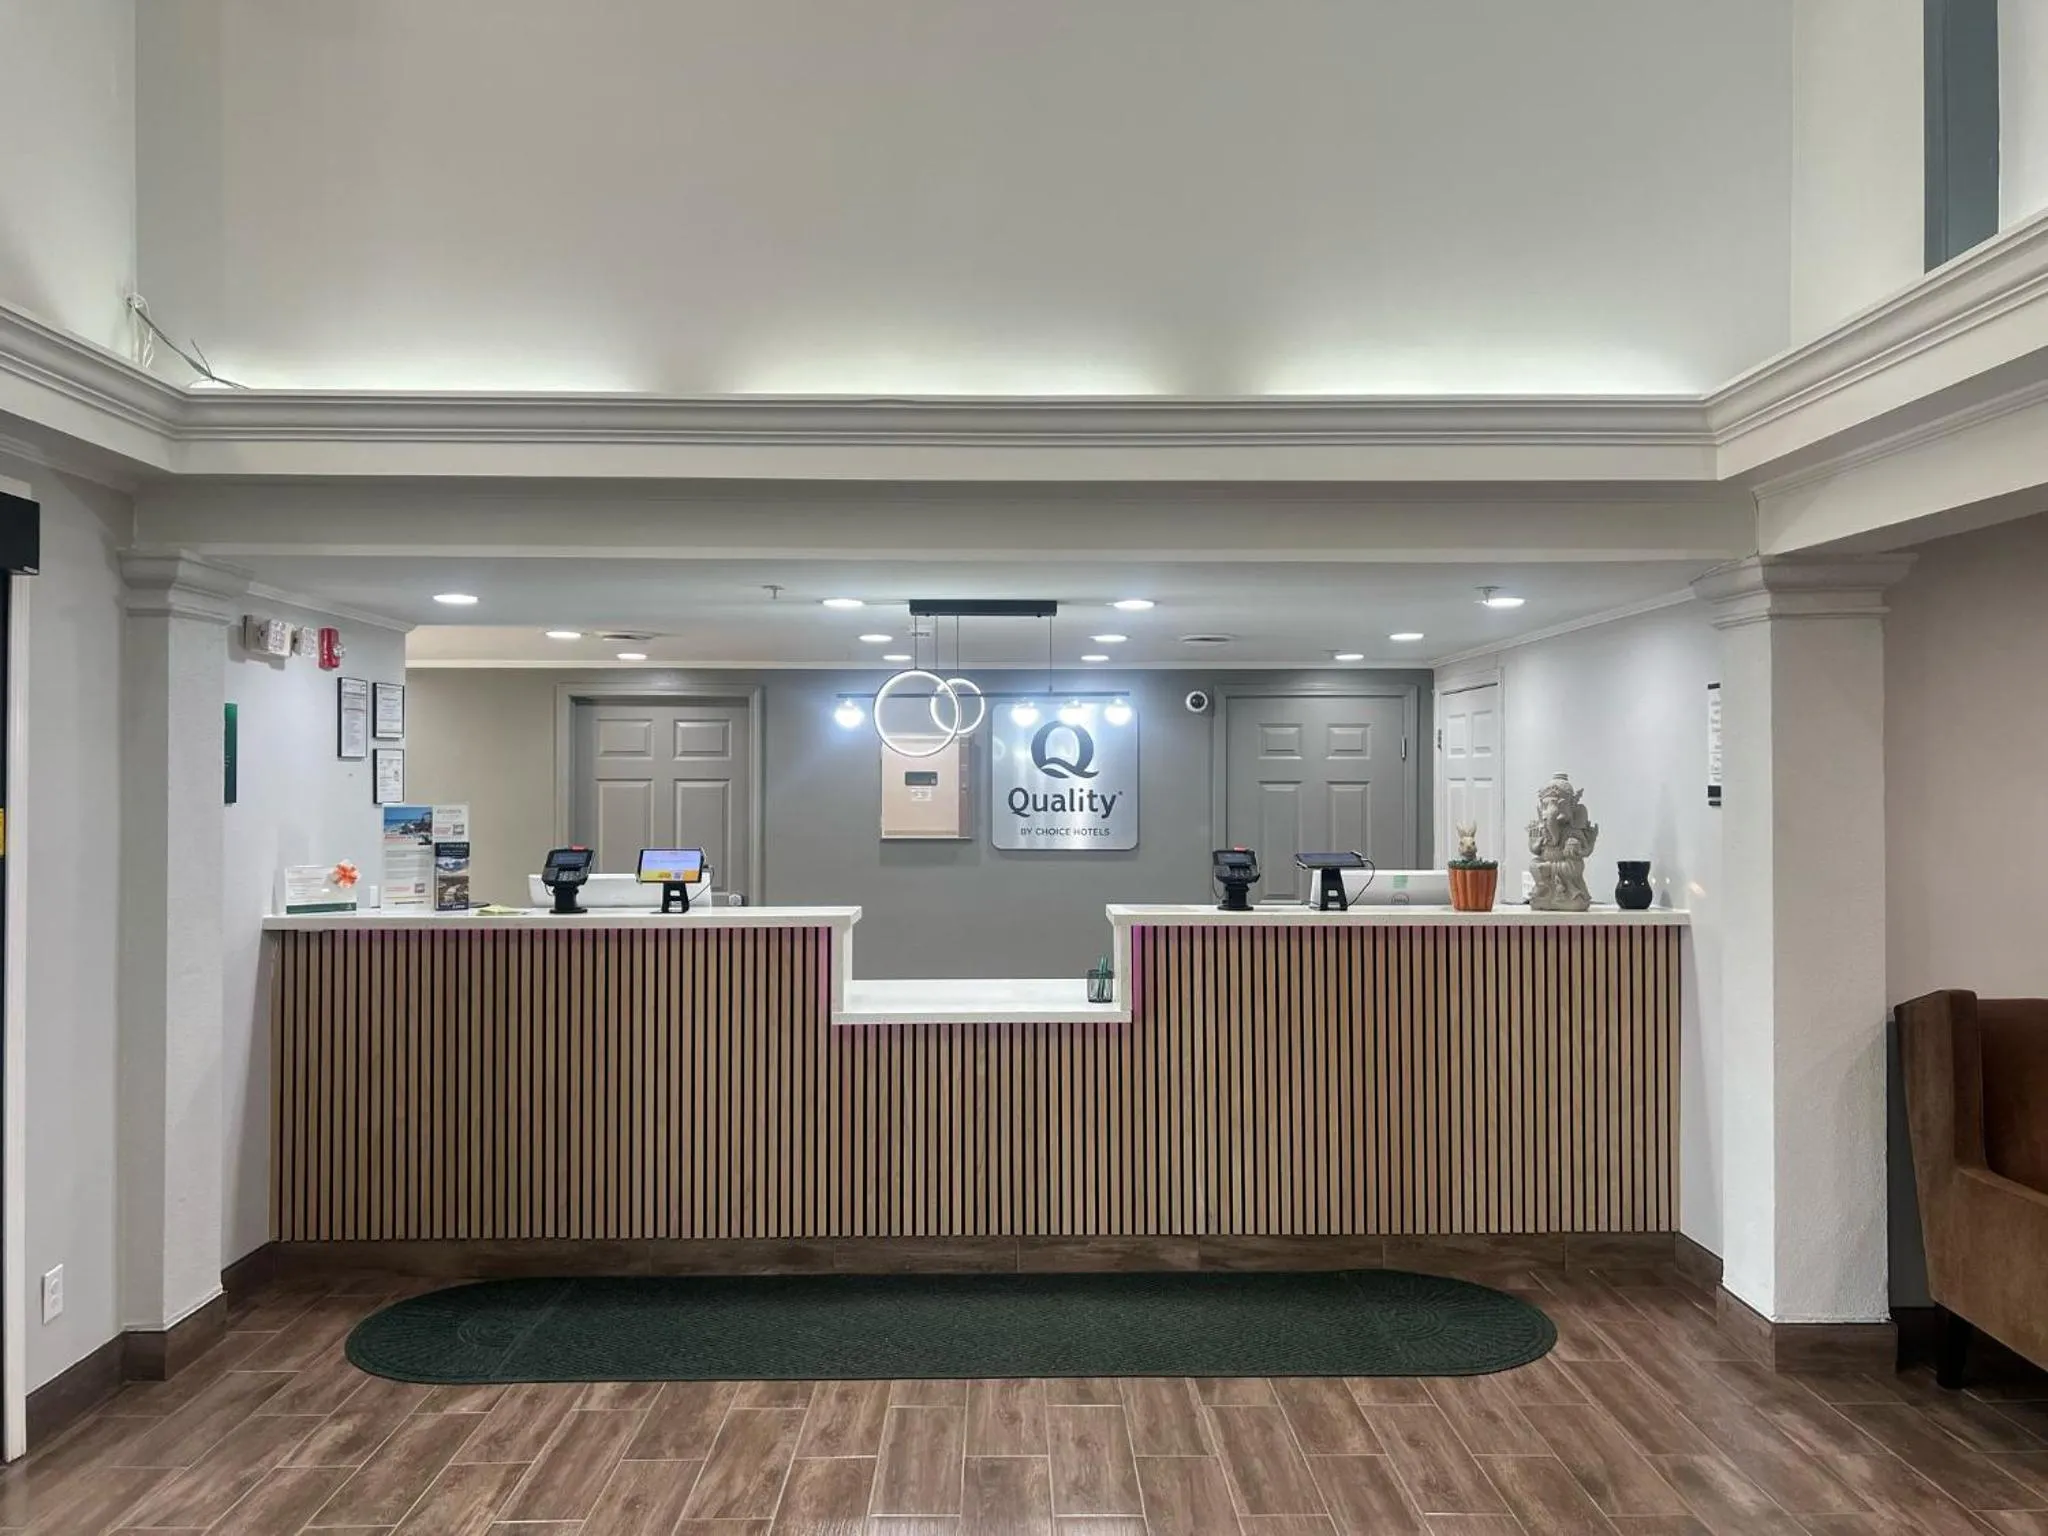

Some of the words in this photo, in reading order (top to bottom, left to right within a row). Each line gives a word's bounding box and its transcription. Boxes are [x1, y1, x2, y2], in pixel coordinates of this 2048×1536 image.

[1031, 720, 1099, 779] Q
[1008, 787, 1116, 819] Quality
[1020, 827, 1033, 836] BY
[1035, 827, 1071, 836] CHOICE
[1074, 827, 1111, 836] HOTELS
